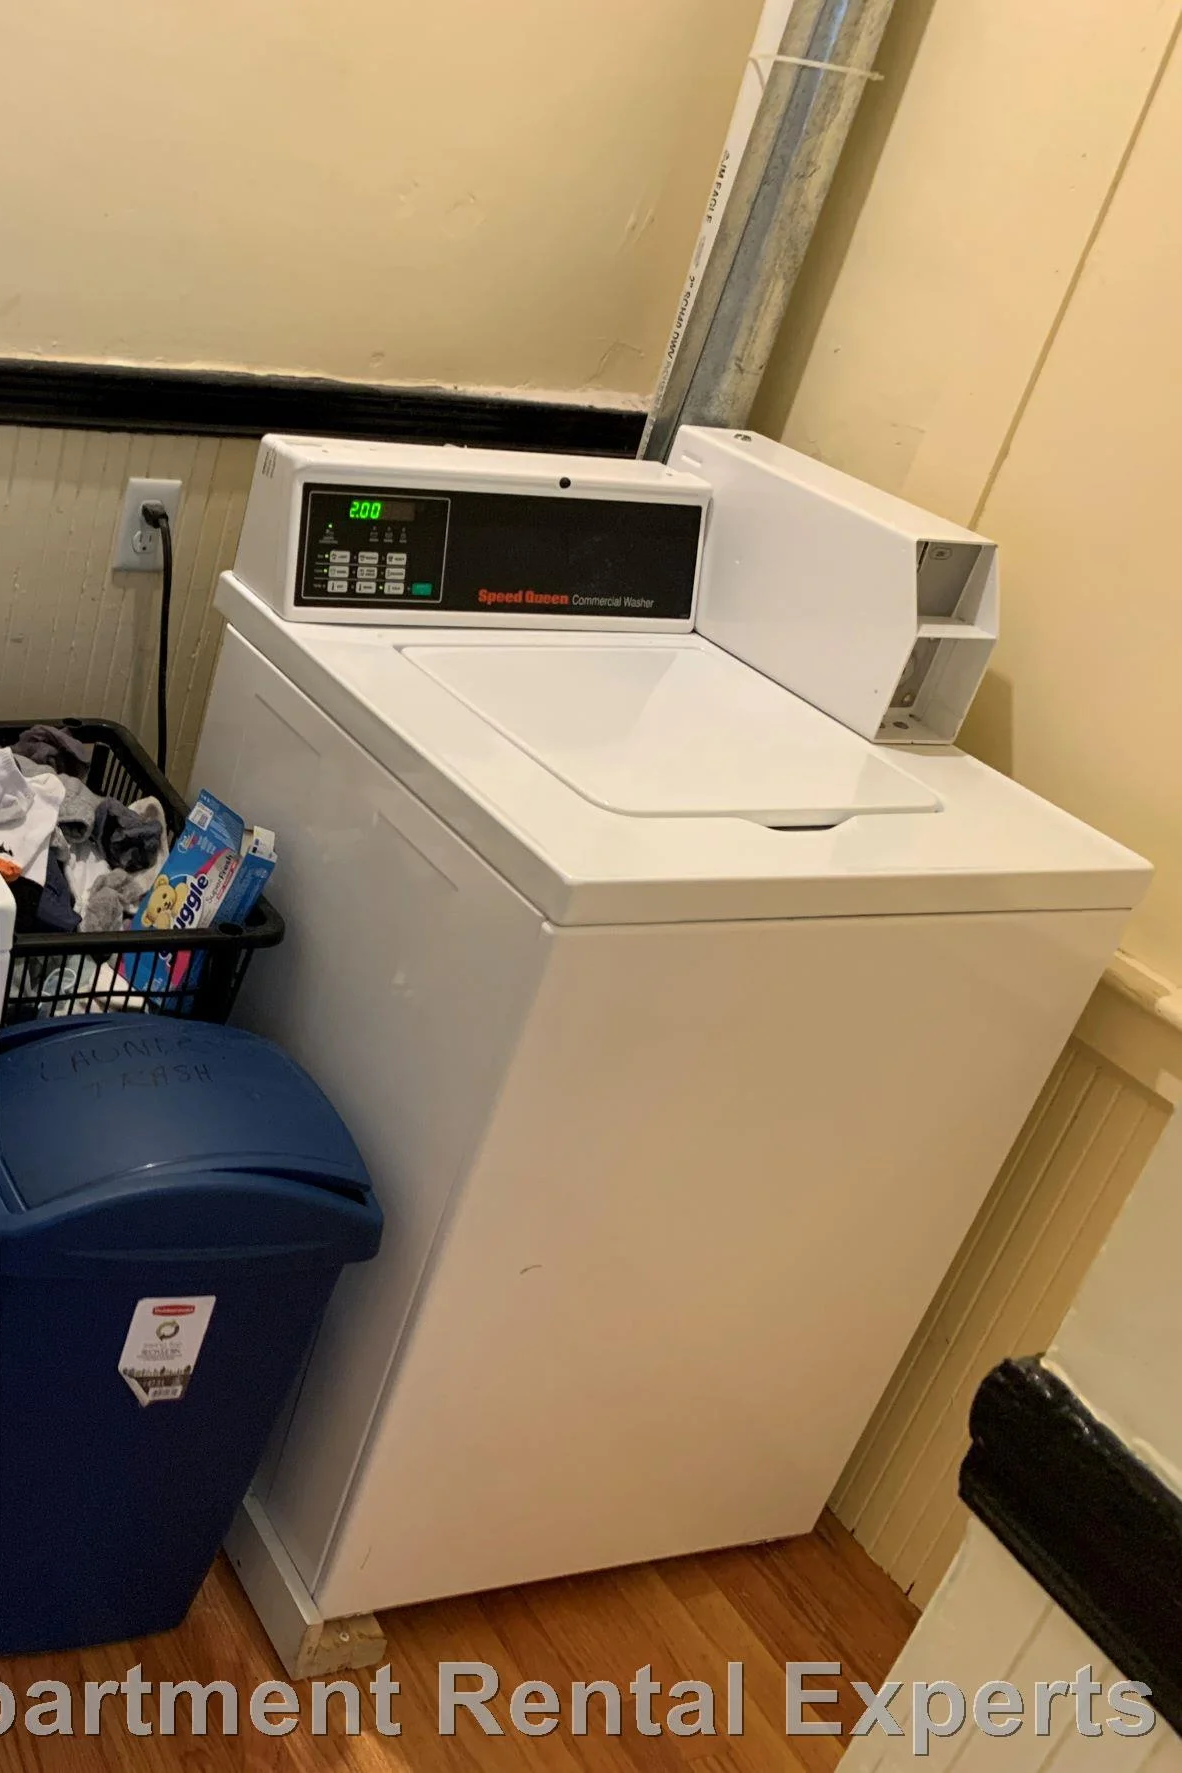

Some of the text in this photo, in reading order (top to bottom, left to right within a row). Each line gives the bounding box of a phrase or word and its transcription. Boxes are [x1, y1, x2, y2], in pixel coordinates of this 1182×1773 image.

[349, 501, 382, 519] 2.00
[478, 589, 655, 608] Speed Queen Commercial Washer
[172, 874, 210, 930] uggle
